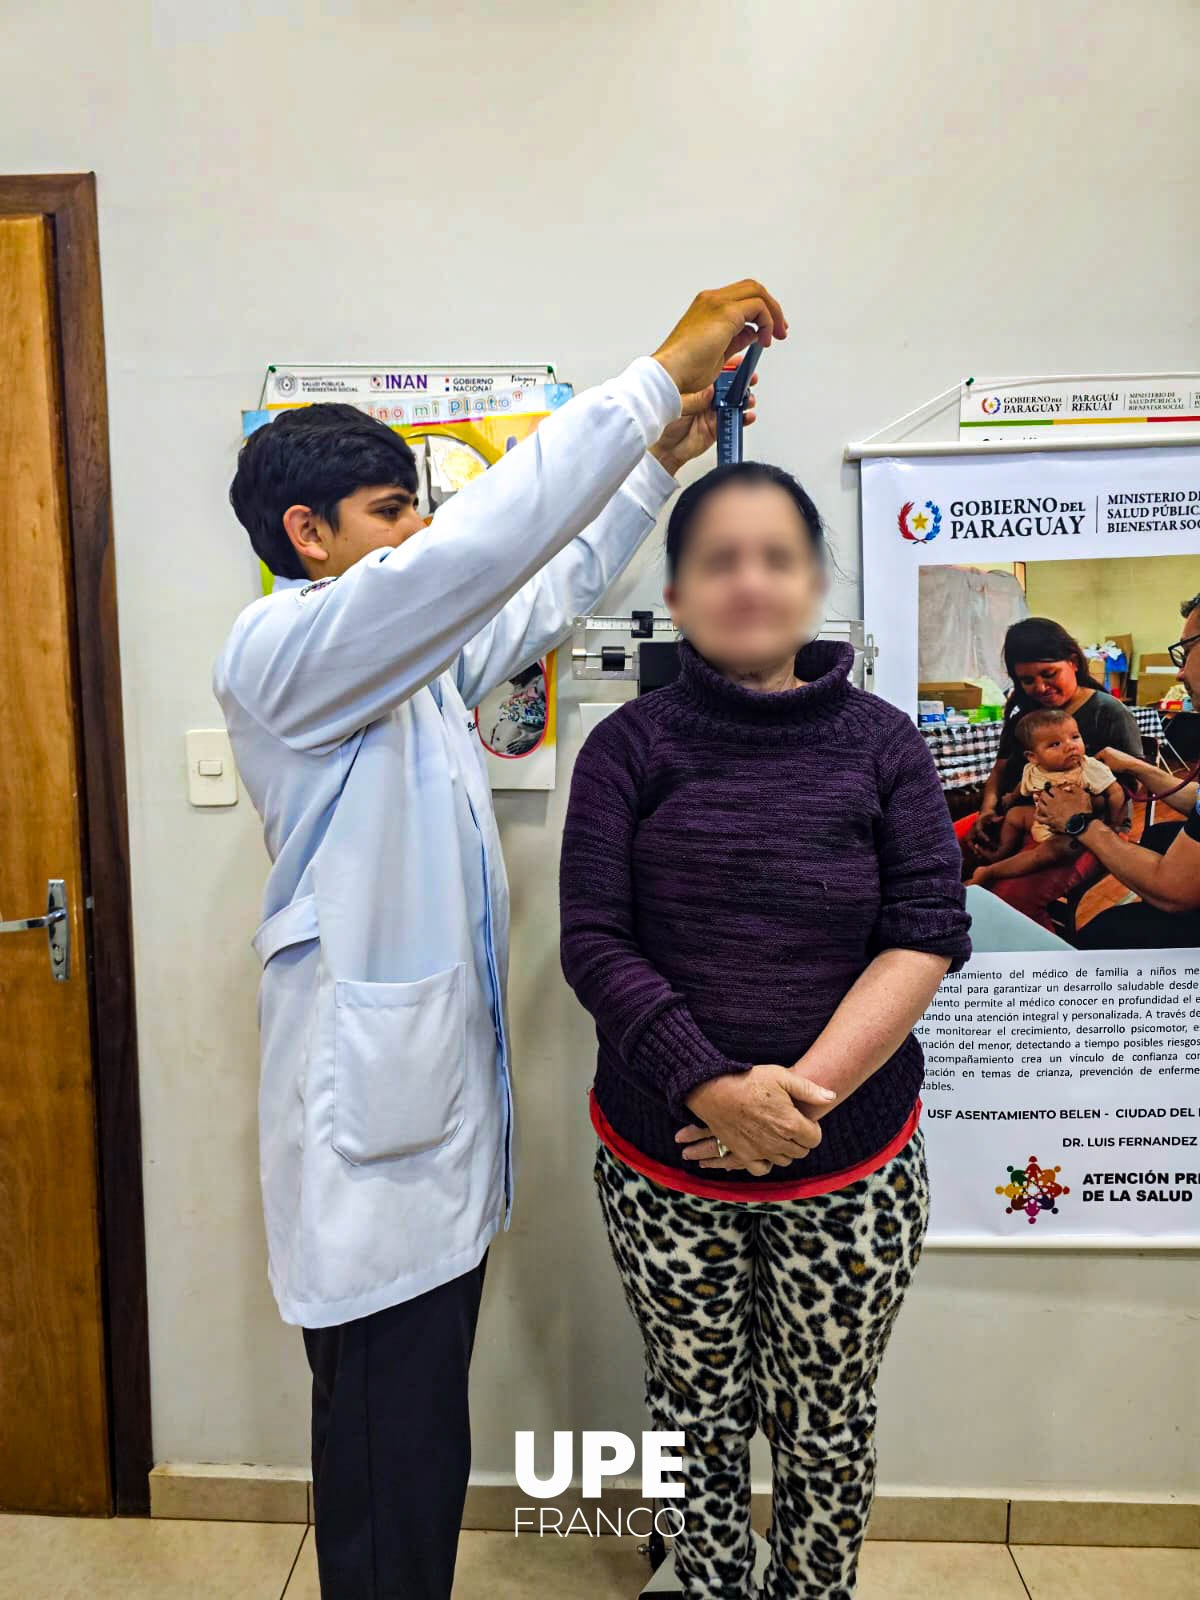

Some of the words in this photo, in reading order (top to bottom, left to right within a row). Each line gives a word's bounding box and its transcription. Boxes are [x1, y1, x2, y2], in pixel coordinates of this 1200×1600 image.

[386, 374, 428, 389] INAN
[1003, 396, 1051, 404] GOBIERNO
[414, 401, 439, 418] mi
[1003, 403, 1063, 413] PARAGUAY
[1108, 492, 1185, 504] MINISTERIO
[950, 498, 1058, 518] GOBIERNO
[1060, 501, 1086, 512] DEL
[1107, 507, 1149, 519] SALUD
[1152, 504, 1200, 517] PÚBLIC
[950, 515, 1086, 540] PARAGUAY
[1107, 520, 1177, 533] BIENESTAR
[1009, 970, 1024, 979] del
[1032, 968, 1068, 978] médico
[1076, 968, 1088, 978] de
[1096, 967, 1129, 977] familia
[1150, 966, 1176, 976] niños
[968, 986, 988, 995] para
[994, 984, 1041, 995] garantizar
[1064, 982, 1112, 992] desarrollo
[1117, 981, 1164, 991] saludable
[1169, 980, 1199, 990] desde
[964, 999, 1003, 1009] permite
[1007, 998, 1015, 1007] al
[1019, 997, 1055, 1007] médico
[1118, 995, 1179, 1007] profundidad
[1183, 995, 1191, 1004] el
[976, 1012, 1019, 1022] atención
[1022, 1011, 1059, 1022] integral
[1063, 1013, 1068, 1022] y
[1072, 1010, 1142, 1022] personalizada.
[1146, 1010, 1152, 1018] A
[1156, 1009, 1186, 1018] través
[936, 1026, 992, 1036] monitorear
[997, 1026, 1006, 1035] el
[1011, 1025, 1071, 1036] crecimiento,
[1076, 1024, 1126, 1034] desarrollo
[1131, 1024, 1188, 1035] psicomotor,
[958, 1040, 974, 1050] del
[978, 1042, 1012, 1051] menor,
[1016, 1040, 1071, 1050] detectando
[1084, 1039, 1120, 1050] tiempo
[1124, 1038, 1164, 1050] posibles
[928, 1055, 1014, 1065] acompañamiento
[1112, 1052, 1124, 1062] de
[1132, 1052, 1178, 1061] confianza
[981, 1070, 1012, 1078] temas
[1017, 1069, 1030, 1078] de
[1036, 1068, 1073, 1078] crianza,
[1079, 1067, 1134, 1078] prevención
[1140, 1066, 1152, 1075] de
[928, 1109, 952, 1119] USF
[955, 1109, 1056, 1120] ASENTAMIENTO
[1060, 1109, 1101, 1120] BELEN
[1115, 1108, 1167, 1118] CIUDAD
[1170, 1107, 1195, 1118] DEL
[1062, 1137, 1084, 1148] DR.
[1087, 1137, 1115, 1147] LUIS
[1118, 1136, 1198, 1147] FERNANDEZ
[1082, 1169, 1169, 1185] ATENCIÓN
[1082, 1190, 1106, 1202] DE
[1109, 1190, 1131, 1202] LA
[1136, 1189, 1193, 1202] SALUD
